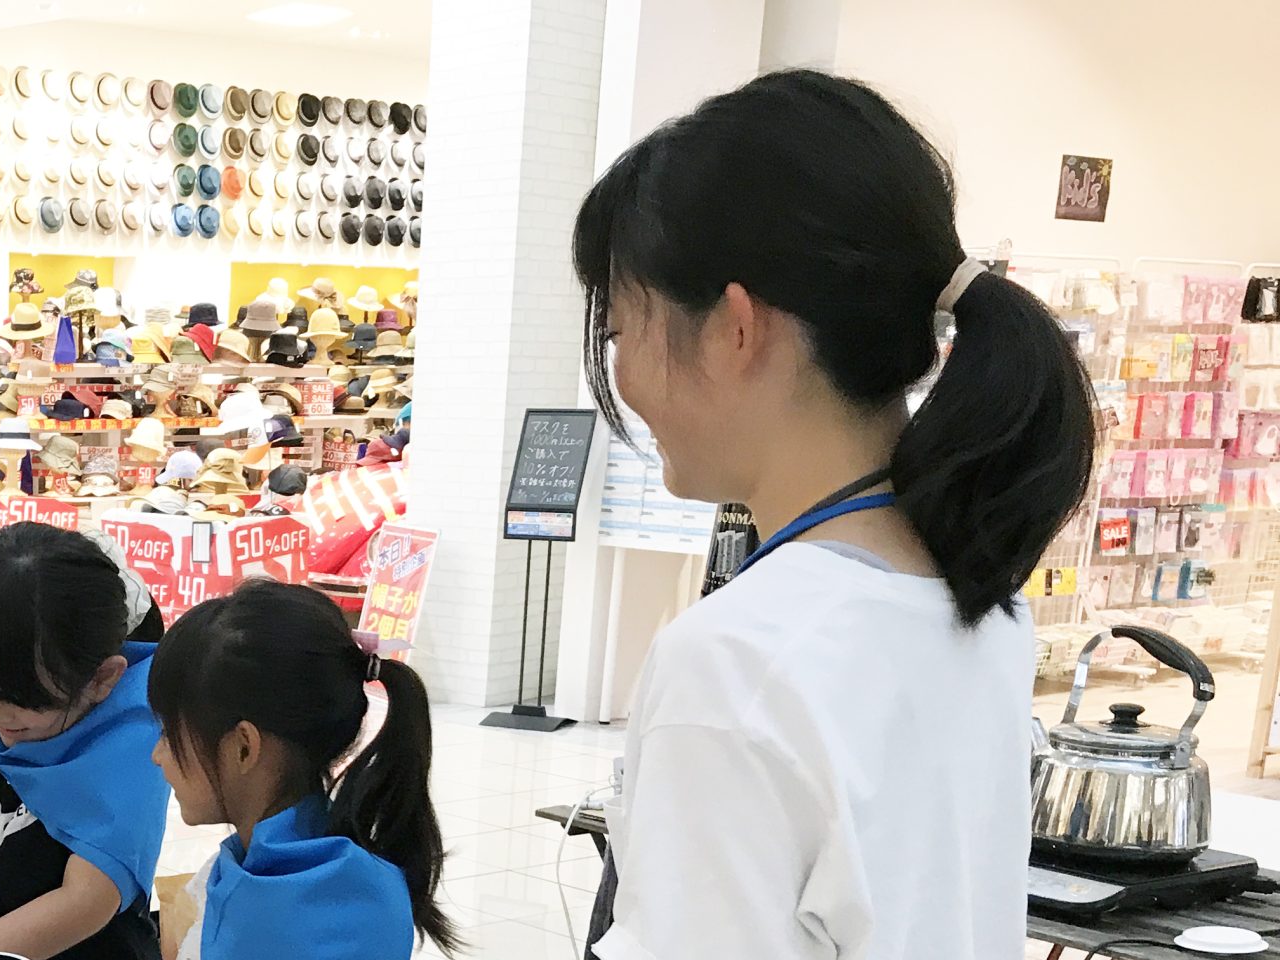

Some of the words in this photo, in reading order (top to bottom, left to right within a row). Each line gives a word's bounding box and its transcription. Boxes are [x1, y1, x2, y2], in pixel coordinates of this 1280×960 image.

[312, 384, 331, 393] SALE
[312, 394, 331, 403] SALE
[531, 421, 569, 435] マスクを
[1103, 526, 1128, 541] SALE
[235, 526, 306, 561] 50%OFF
[371, 583, 420, 615] 帽子が
